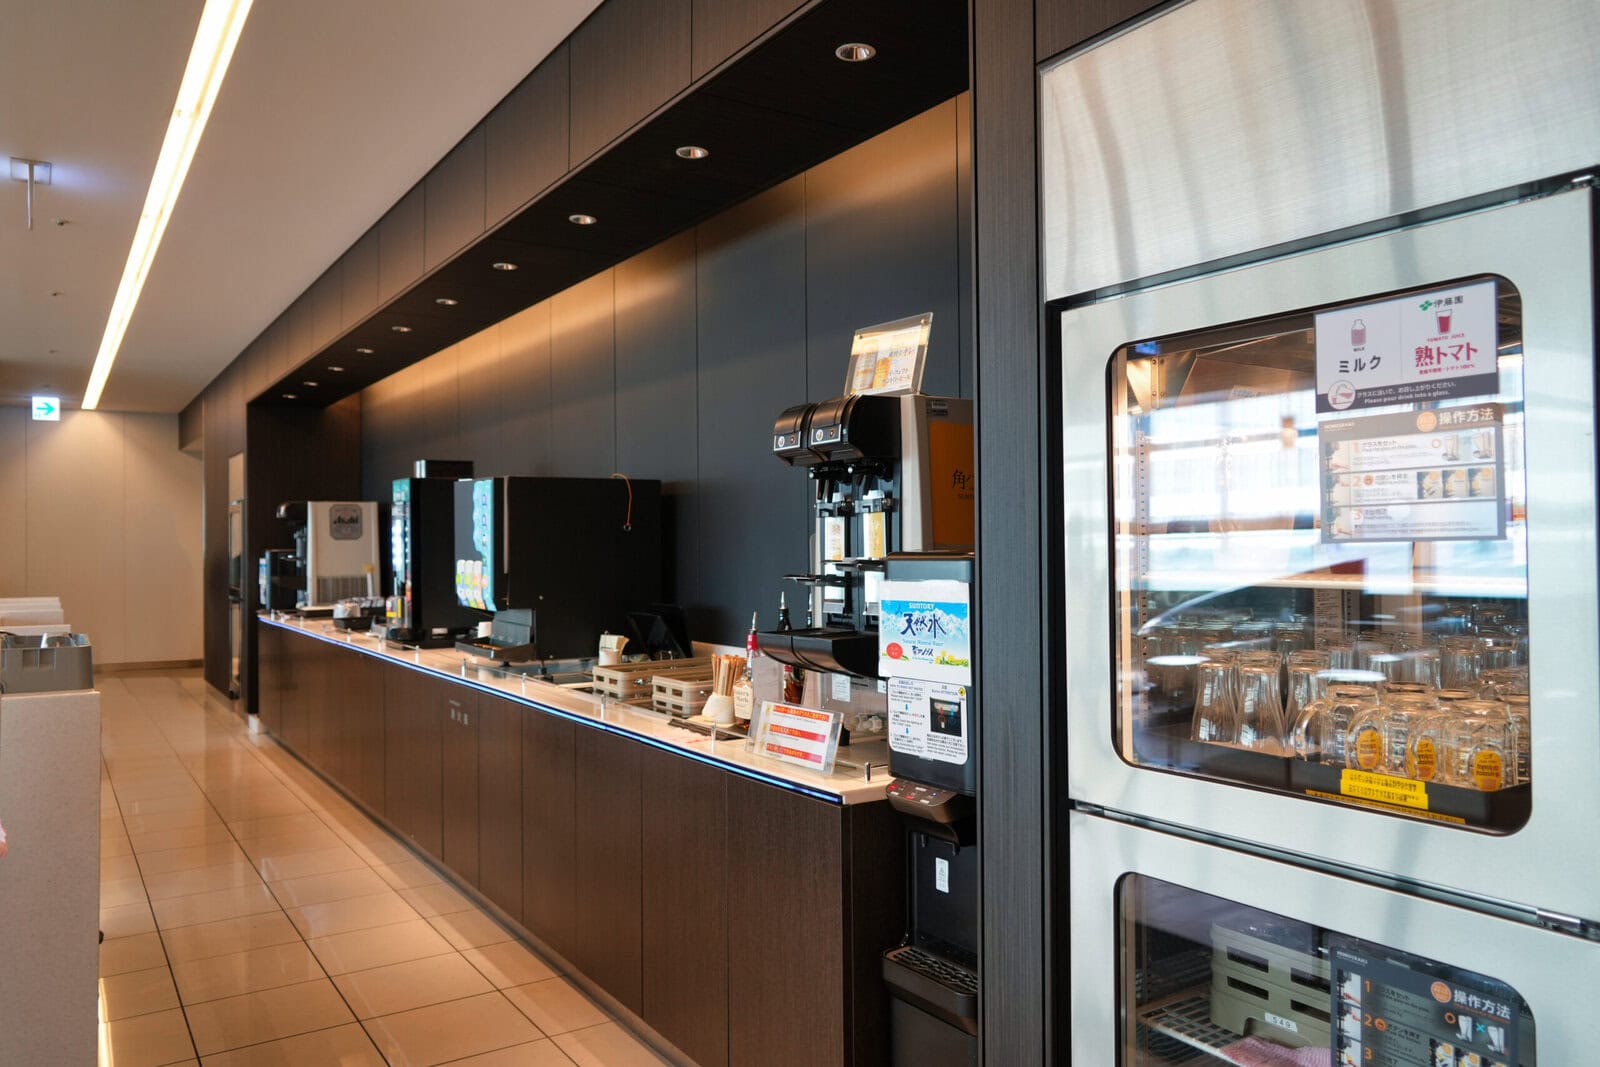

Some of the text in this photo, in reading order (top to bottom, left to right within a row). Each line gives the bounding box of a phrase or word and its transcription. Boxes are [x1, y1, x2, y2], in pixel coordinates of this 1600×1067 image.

[1433, 295, 1463, 308] 伊藤園
[1415, 342, 1478, 368] 熟トマト
[1338, 355, 1382, 374] ミルク
[1439, 407, 1494, 425] 操作方法
[909, 602, 935, 610] SUNTORY
[900, 613, 947, 639] 天然水
[1364, 980, 1371, 993] 1
[1453, 989, 1511, 1020] 操作方法
[1364, 1014, 1372, 1027] 2
[1364, 1047, 1372, 1060] 3
